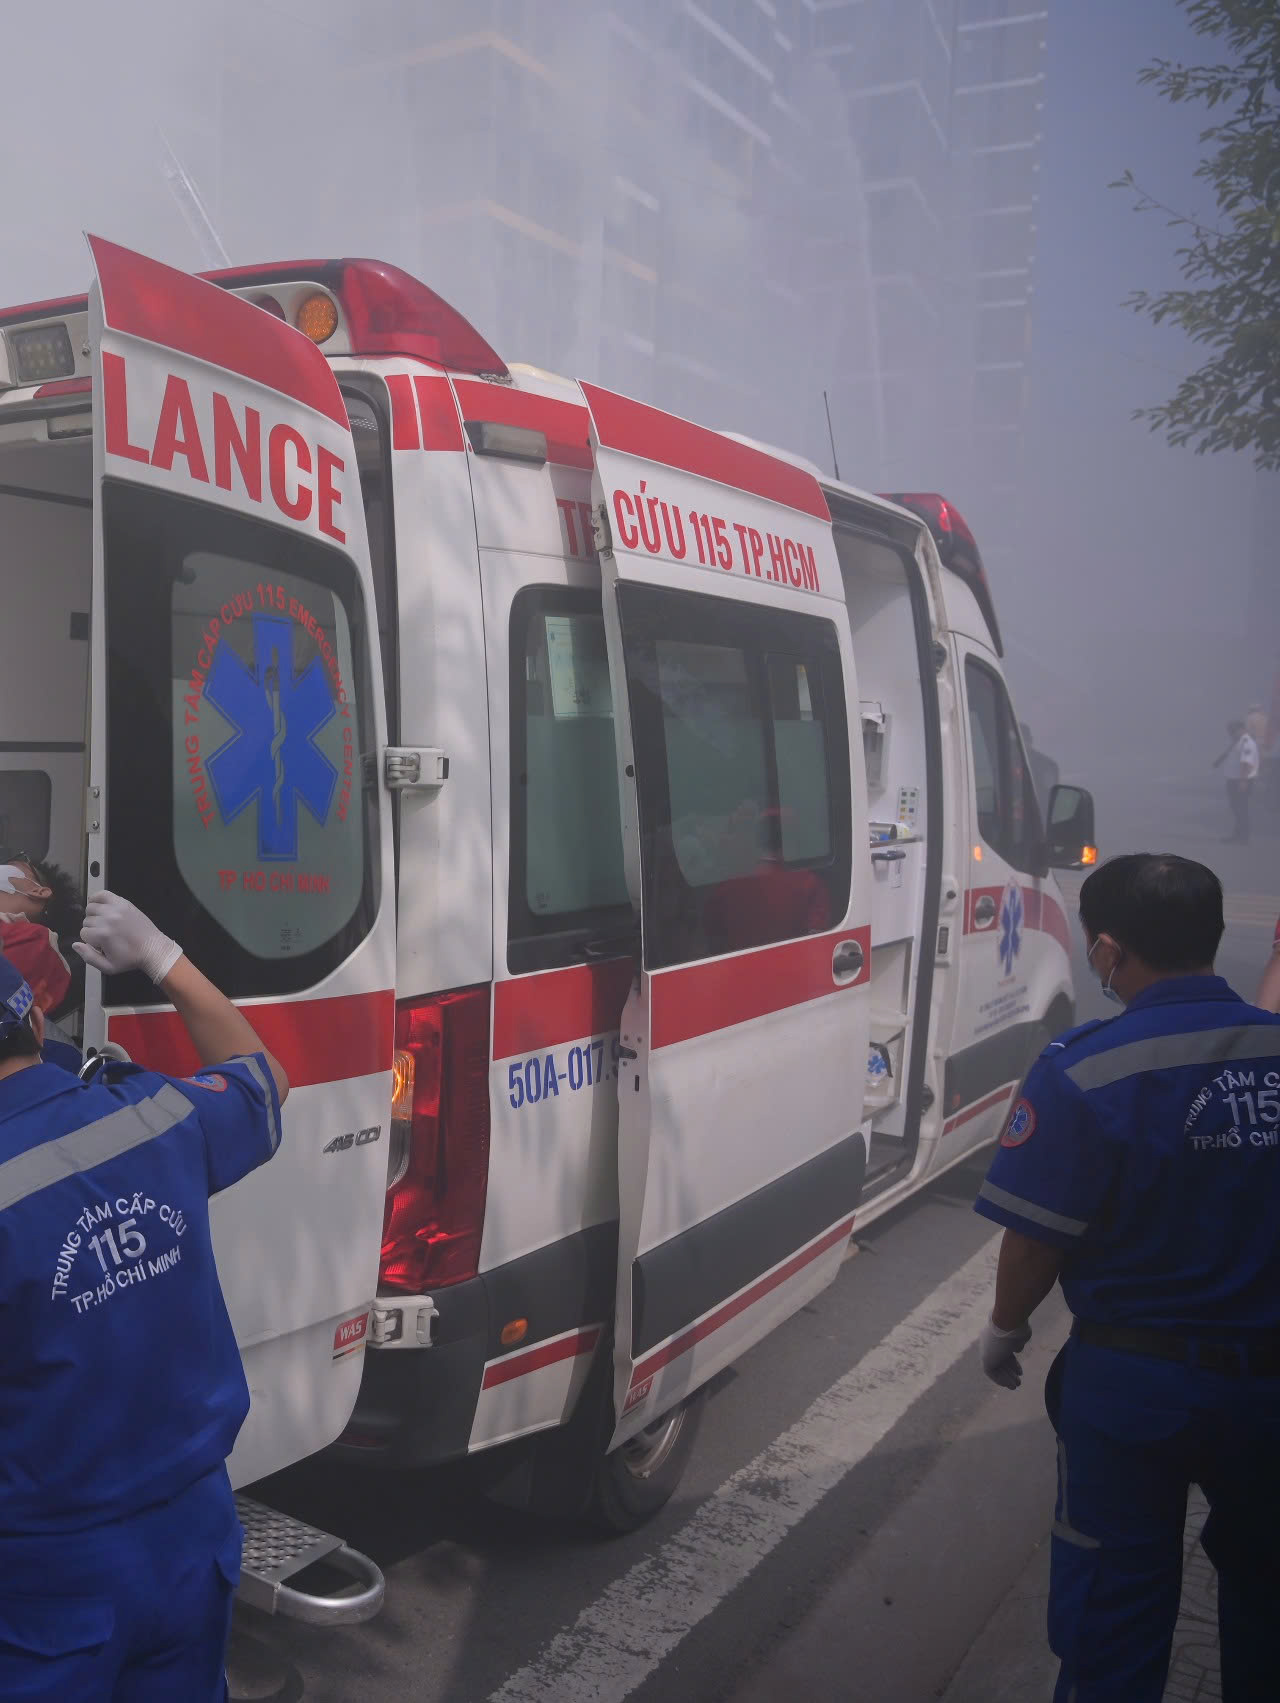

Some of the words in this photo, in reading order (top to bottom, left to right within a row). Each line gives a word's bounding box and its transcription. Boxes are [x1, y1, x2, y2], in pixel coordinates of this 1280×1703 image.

[102, 351, 346, 545] LANCE
[612, 480, 686, 559] CỨU
[689, 511, 733, 570] 115
[732, 522, 820, 592] TP.HCM
[185, 736, 217, 830] TRUNG
[256, 583, 286, 609] 115
[289, 598, 353, 718] EMERGENCY
[337, 727, 353, 823] CENTER
[1184, 1087, 1213, 1135] TRUNG
[1212, 1069, 1255, 1091] TÂM
[1222, 1090, 1280, 1125] 115
[51, 1231, 81, 1301] TRUNG
[76, 1201, 113, 1232] TÂM
[115, 1192, 157, 1215] CẤP
[159, 1204, 188, 1237] CỨU
[88, 1218, 147, 1272] 115
[115, 1258, 147, 1288] CHÍ
[148, 1244, 182, 1277] MINH
[340, 1320, 363, 1342] WAS
